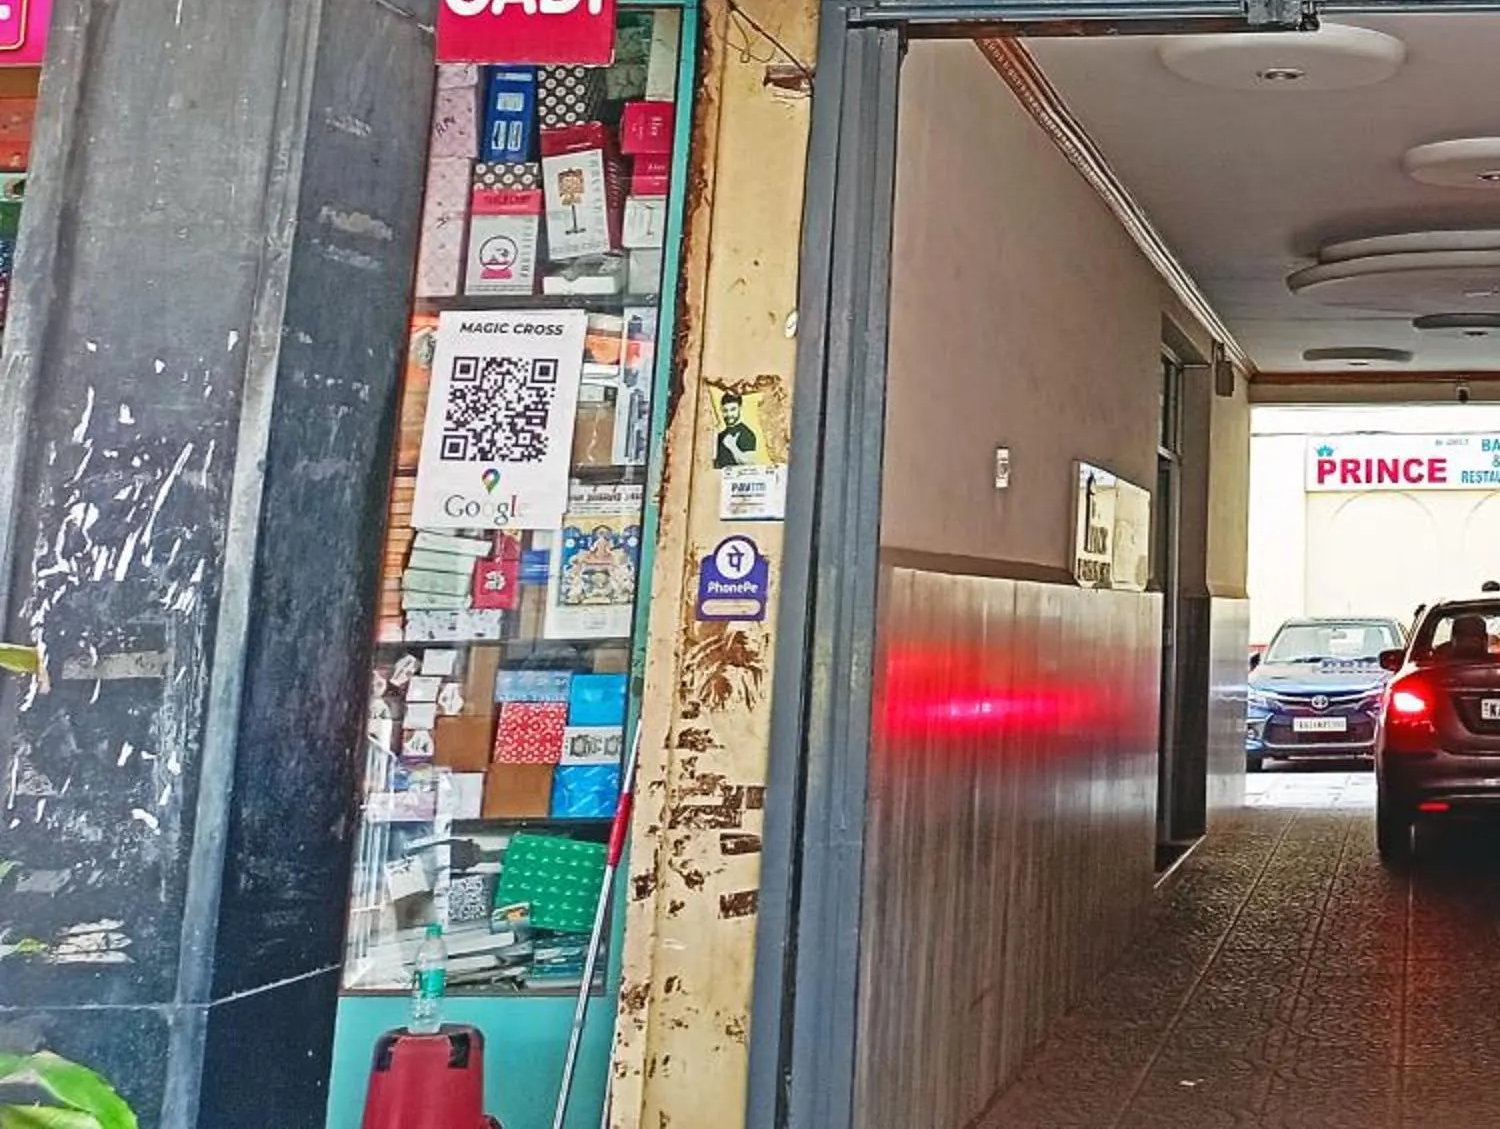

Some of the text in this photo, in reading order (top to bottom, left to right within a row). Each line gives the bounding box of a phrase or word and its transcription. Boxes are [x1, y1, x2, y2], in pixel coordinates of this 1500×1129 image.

[459, 322, 564, 336] MAGIC CROSS
[1316, 457, 1448, 485] PRINCE
[707, 580, 759, 594] PhonePe
